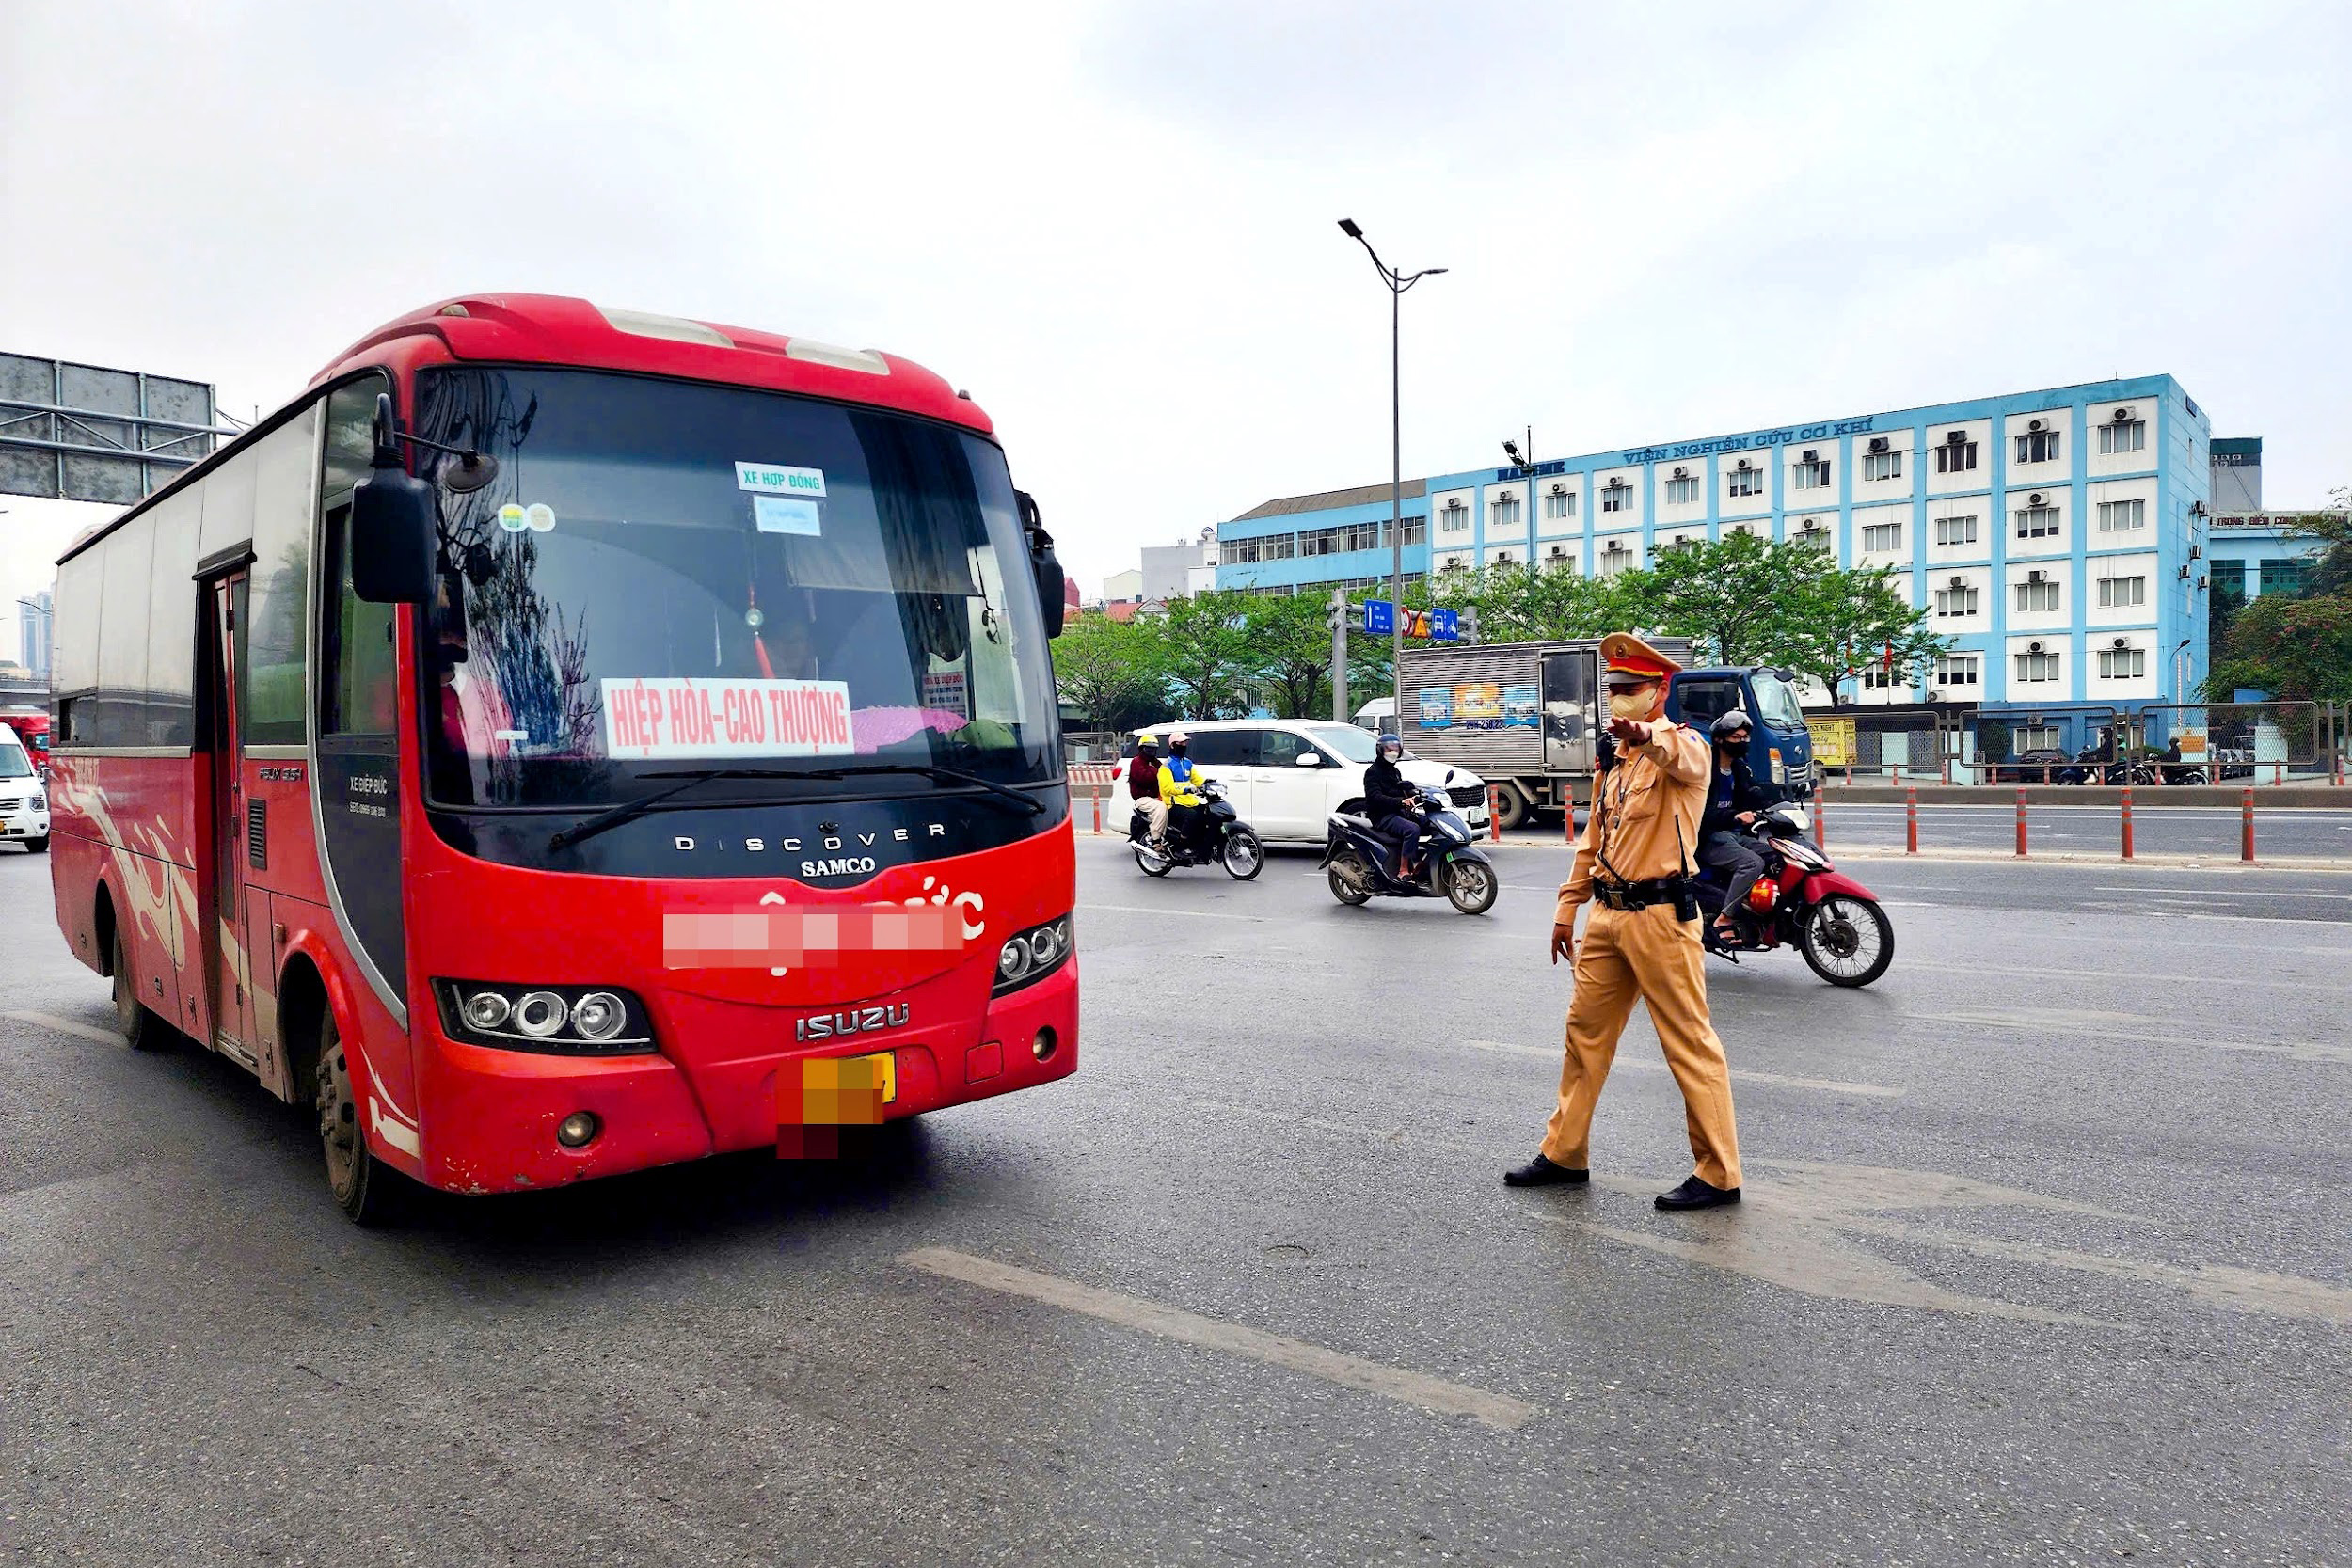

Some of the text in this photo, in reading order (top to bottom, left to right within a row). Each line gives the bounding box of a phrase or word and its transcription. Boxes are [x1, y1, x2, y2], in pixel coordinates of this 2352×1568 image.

[1623, 417, 1874, 465] VIỆN NGHIÊN CỨU CƠ KHÍ
[743, 470, 758, 483] XE
[762, 472, 785, 489] HỢP
[611, 675, 664, 756] HIỆP
[769, 685, 849, 754] THƯỢNG
[349, 775, 358, 791] XE
[801, 856, 876, 878] SAMCO
[796, 1002, 910, 1042] ISUZU
